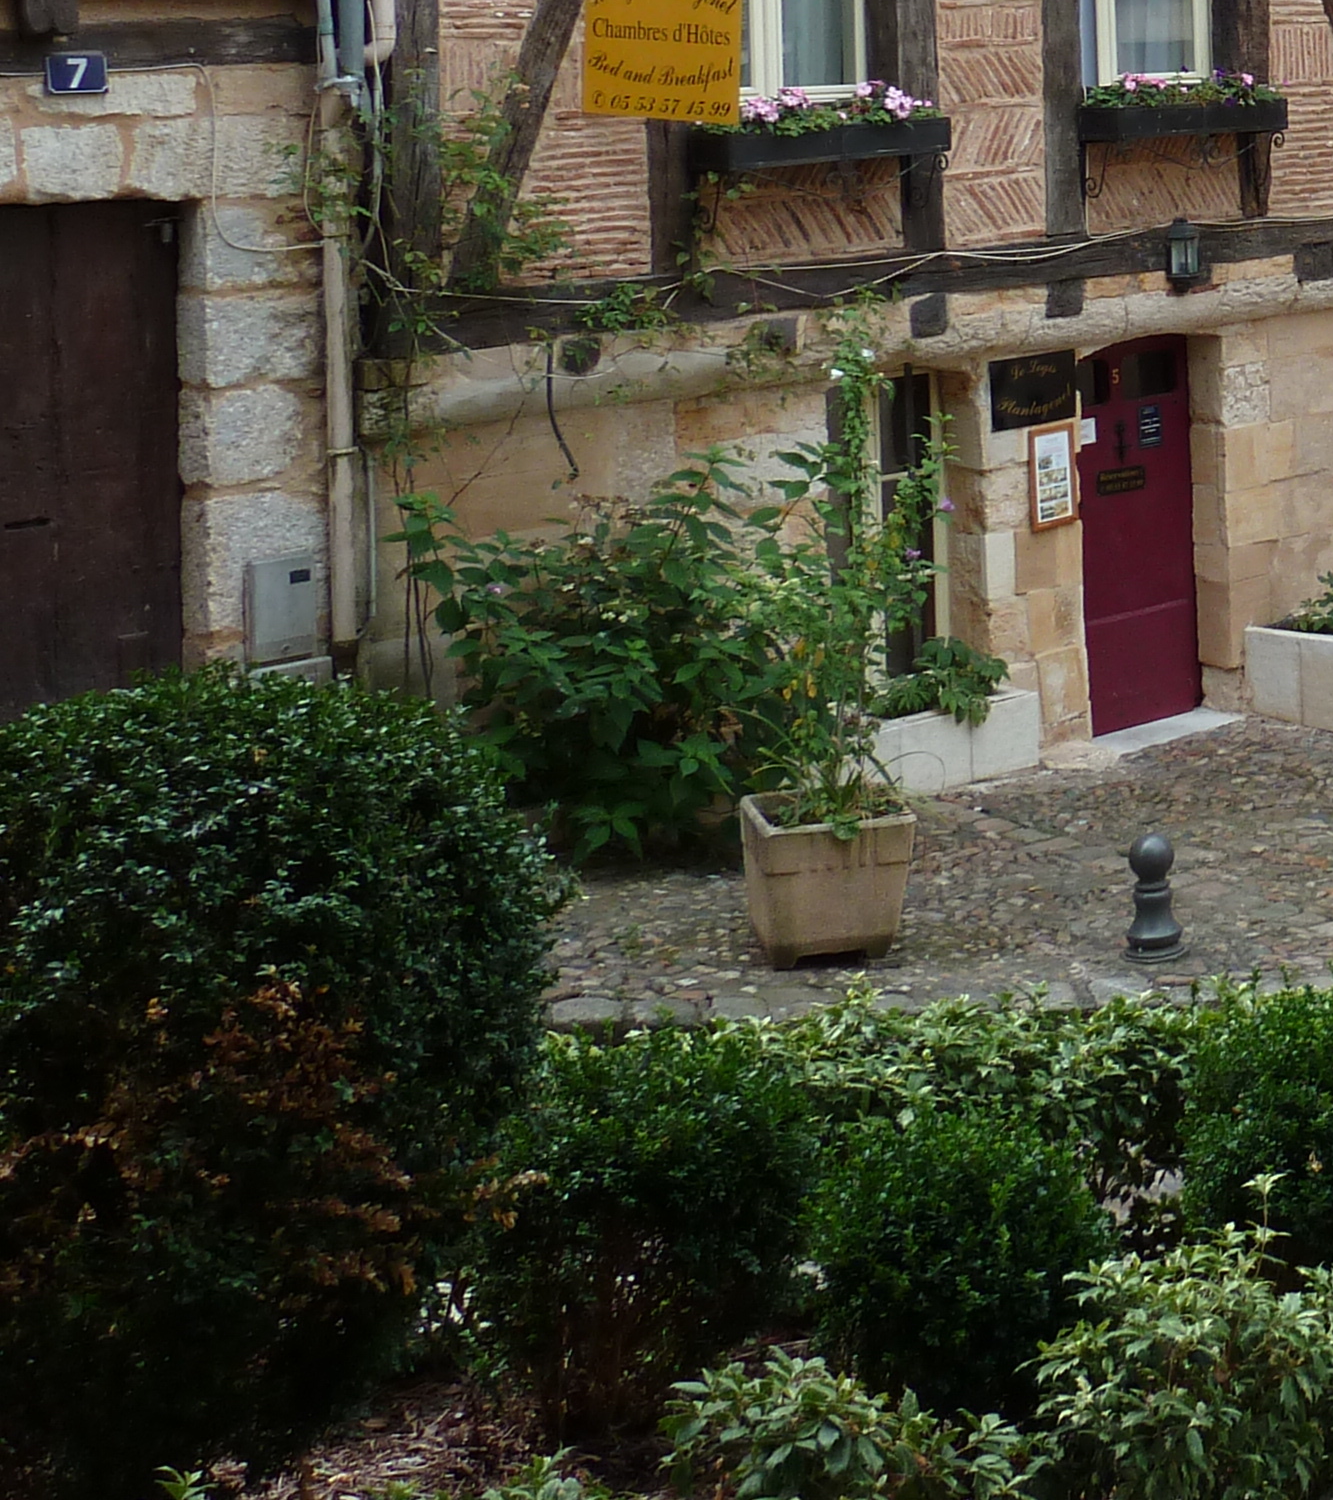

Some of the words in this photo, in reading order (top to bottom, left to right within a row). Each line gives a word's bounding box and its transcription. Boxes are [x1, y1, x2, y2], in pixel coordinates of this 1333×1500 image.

[592, 17, 669, 41] Chambres
[672, 23, 732, 46] d'Hôtes
[66, 57, 89, 89] 7
[588, 49, 624, 76] Bed
[623, 65, 656, 85] and
[658, 56, 735, 93] Breakfast
[610, 95, 632, 110] 05
[634, 96, 656, 113] 53
[658, 98, 681, 114] 57
[684, 100, 707, 116] 15
[708, 101, 732, 118] 99
[1027, 360, 1057, 378] Logis
[1111, 368, 1121, 385] 5
